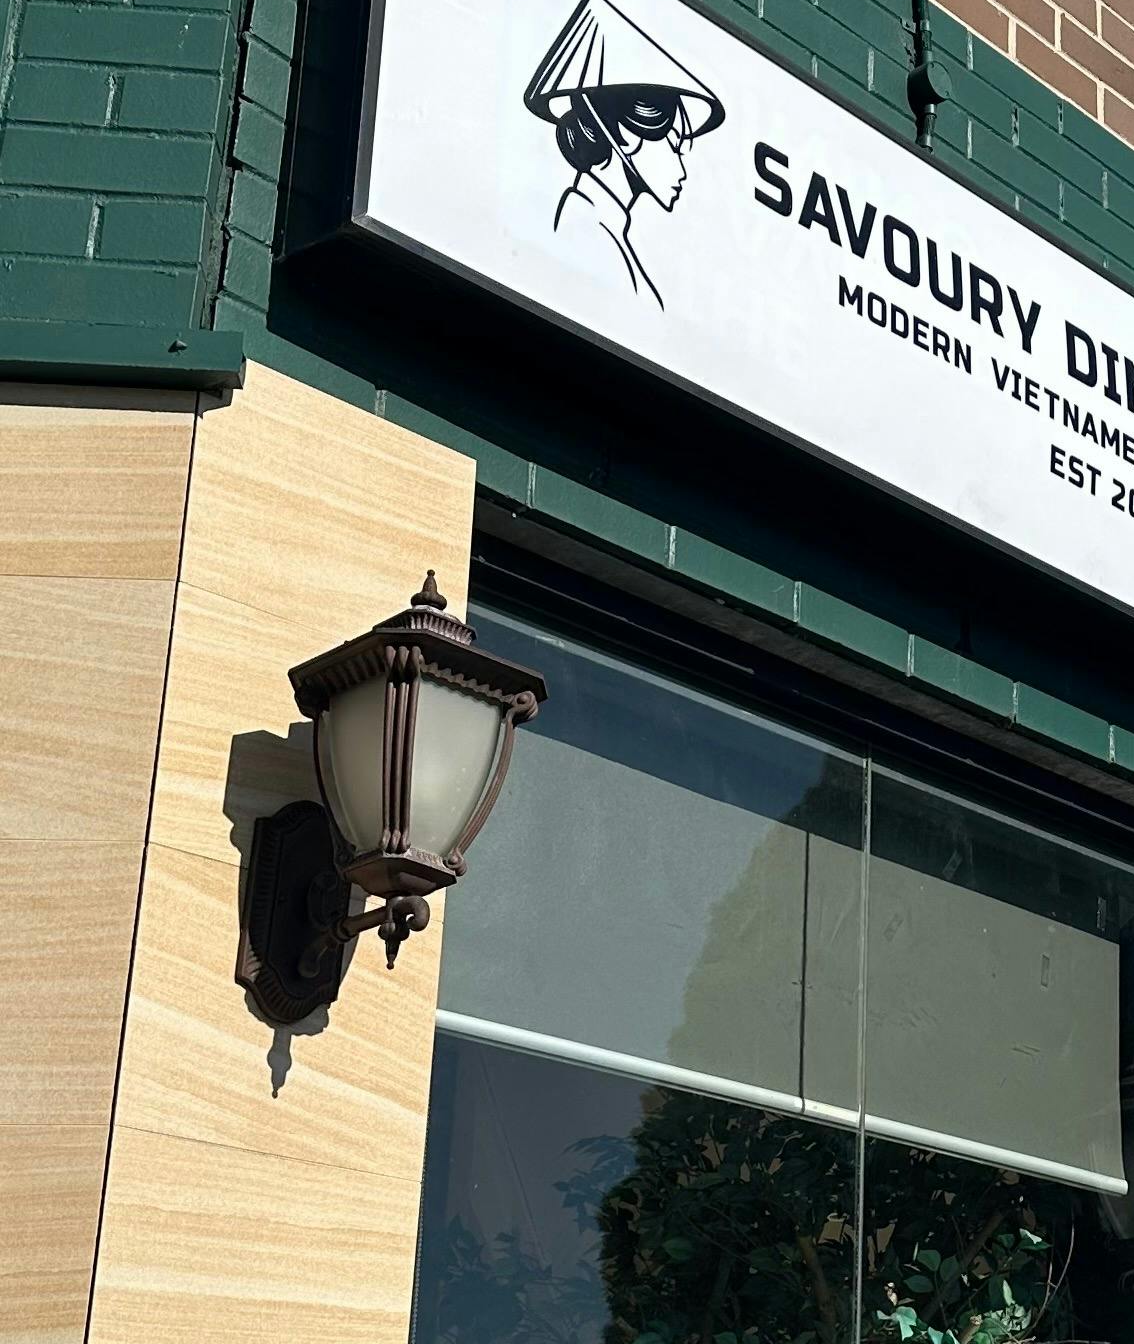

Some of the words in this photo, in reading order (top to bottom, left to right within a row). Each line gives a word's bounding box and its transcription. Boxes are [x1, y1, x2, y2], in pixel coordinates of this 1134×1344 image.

[753, 141, 1042, 355] SAVOURY
[838, 275, 972, 375] MODERN
[1050, 443, 1102, 497] EST
